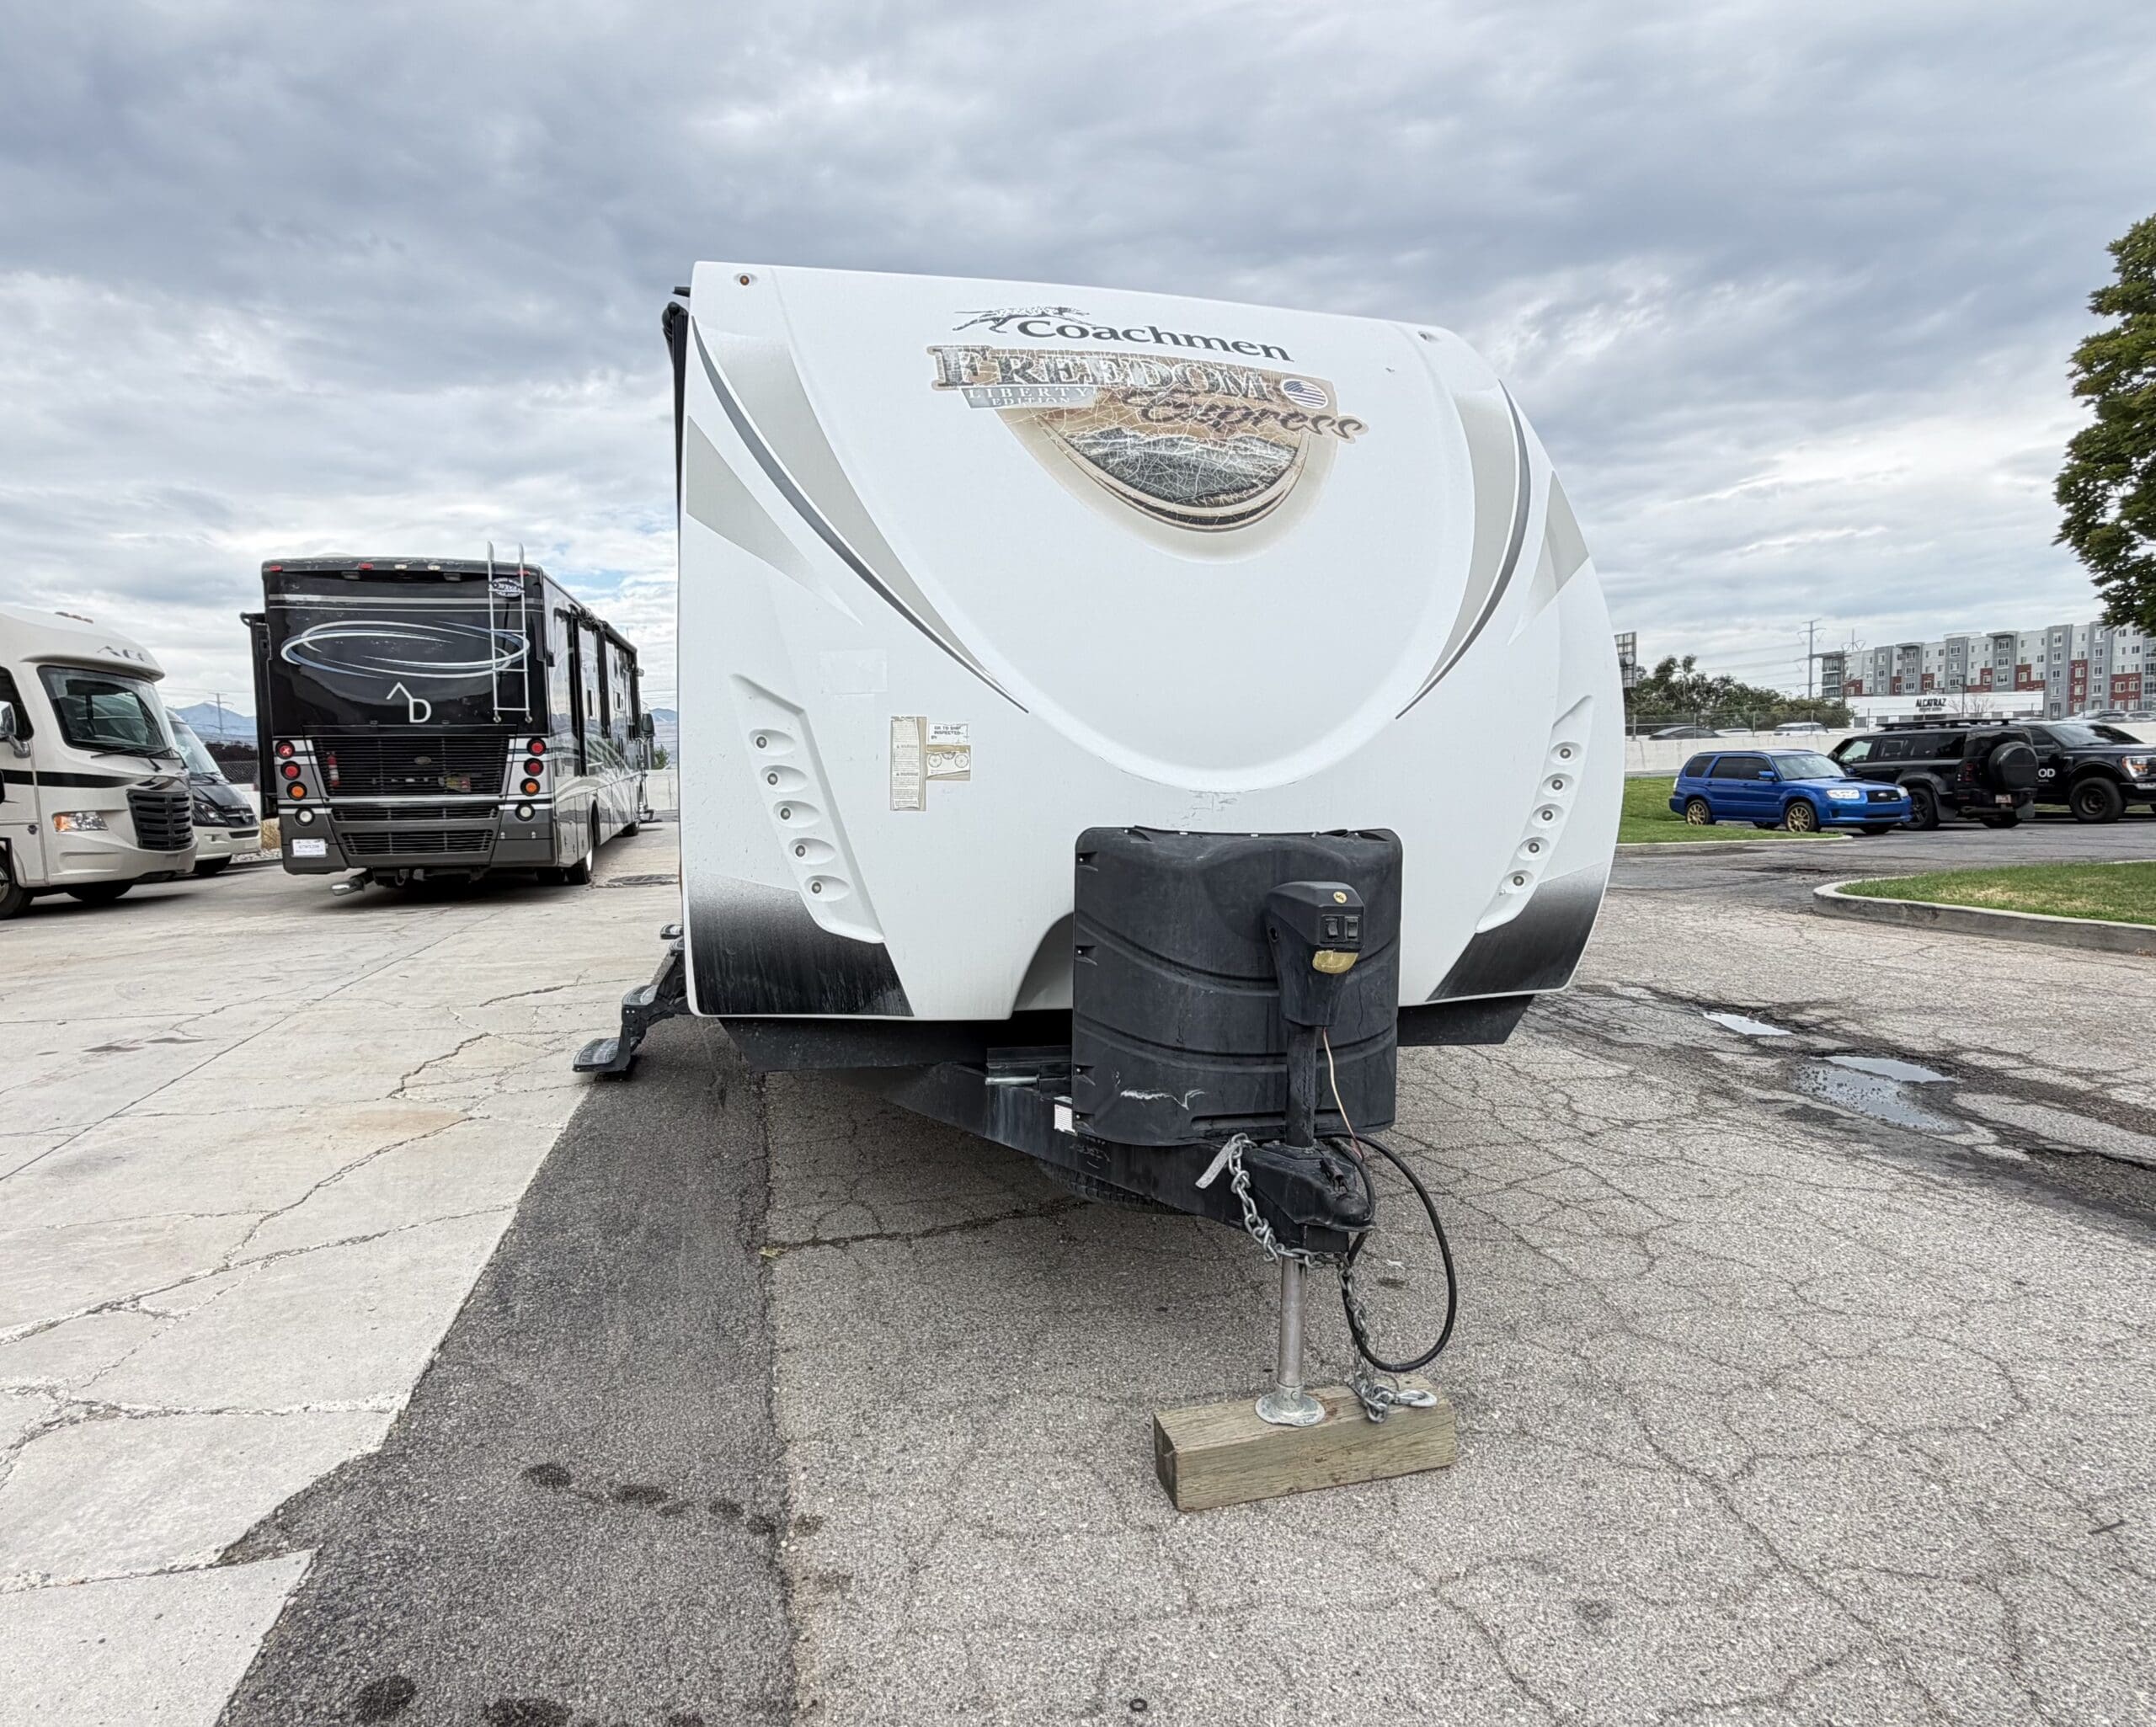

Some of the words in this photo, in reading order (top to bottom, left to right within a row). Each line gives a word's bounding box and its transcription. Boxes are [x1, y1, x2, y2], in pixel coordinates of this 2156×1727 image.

[1017, 321, 1294, 362] Coachmen
[969, 387, 1088, 398] LIBERTY
[992, 397, 1070, 406] EDITION
[1915, 698, 1946, 707] ALCATRAZ
